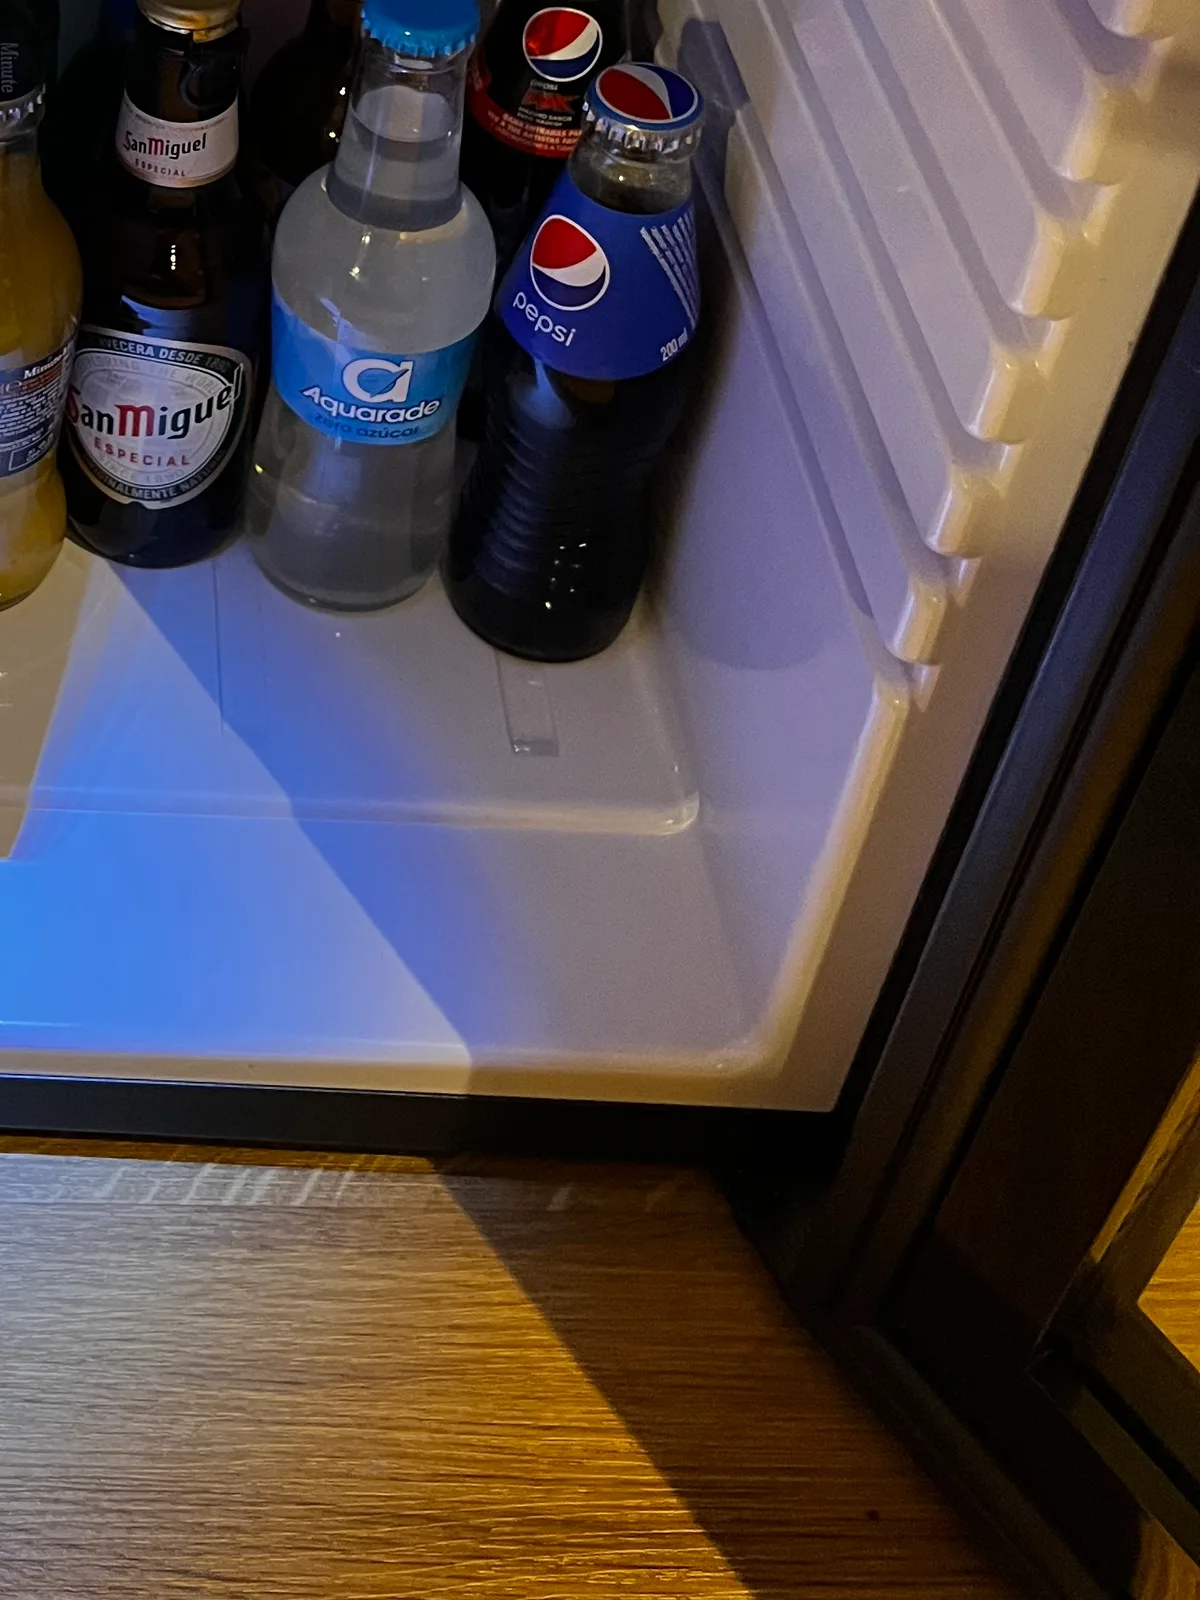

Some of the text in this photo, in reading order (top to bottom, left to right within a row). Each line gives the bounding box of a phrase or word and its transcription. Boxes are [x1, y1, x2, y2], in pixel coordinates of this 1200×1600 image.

[0, 42, 19, 93] Minute
[135, 158, 187, 177] ESPECIAL
[512, 291, 577, 347] pepsi
[158, 346, 202, 366] DESDE
[659, 337, 679, 363] 200
[300, 385, 441, 424] Aquarade
[94, 437, 191, 467] ESPECIAL
